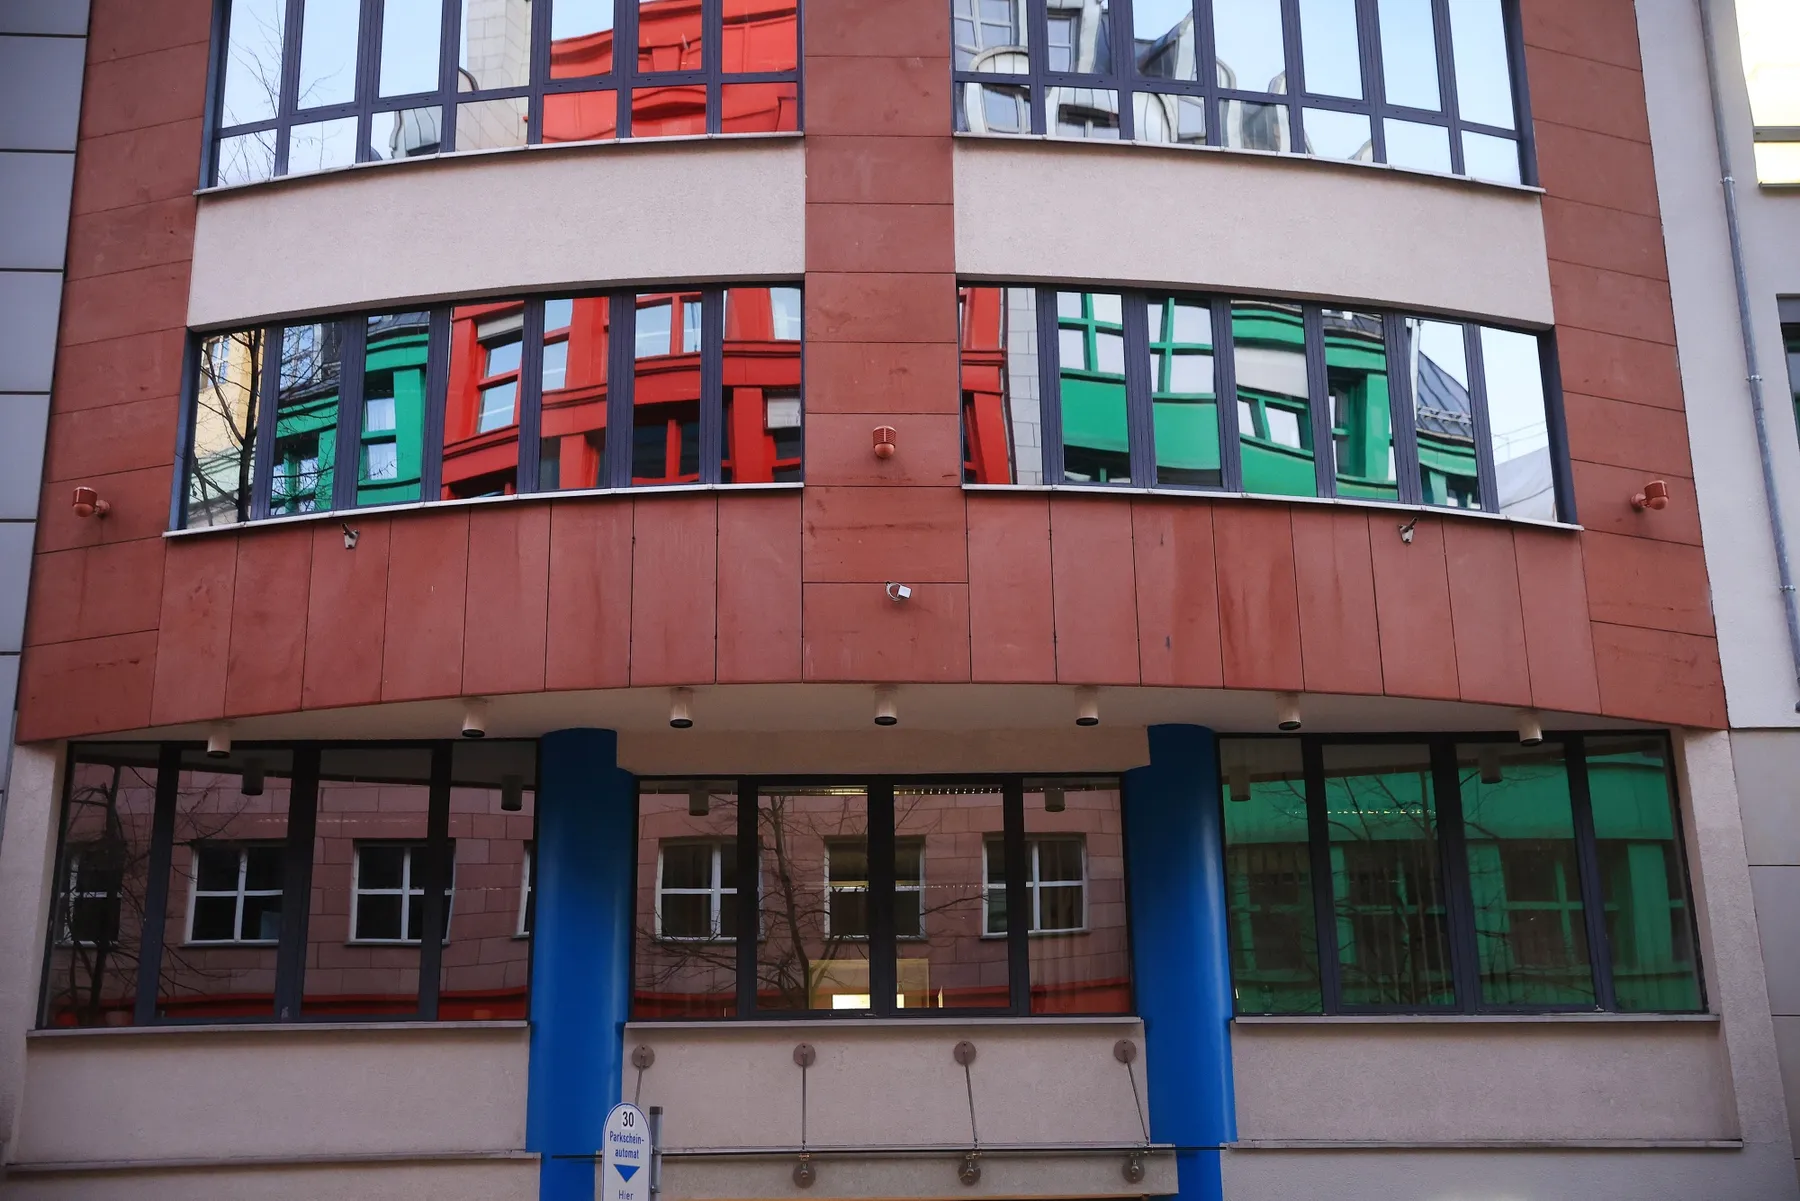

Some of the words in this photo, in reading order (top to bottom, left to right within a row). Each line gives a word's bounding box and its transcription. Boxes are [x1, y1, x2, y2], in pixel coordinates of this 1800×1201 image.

[622, 1111, 635, 1127] 30
[609, 1130, 645, 1144] Parkschein-
[615, 1148, 640, 1159] automat
[618, 1189, 634, 1200] Hier
